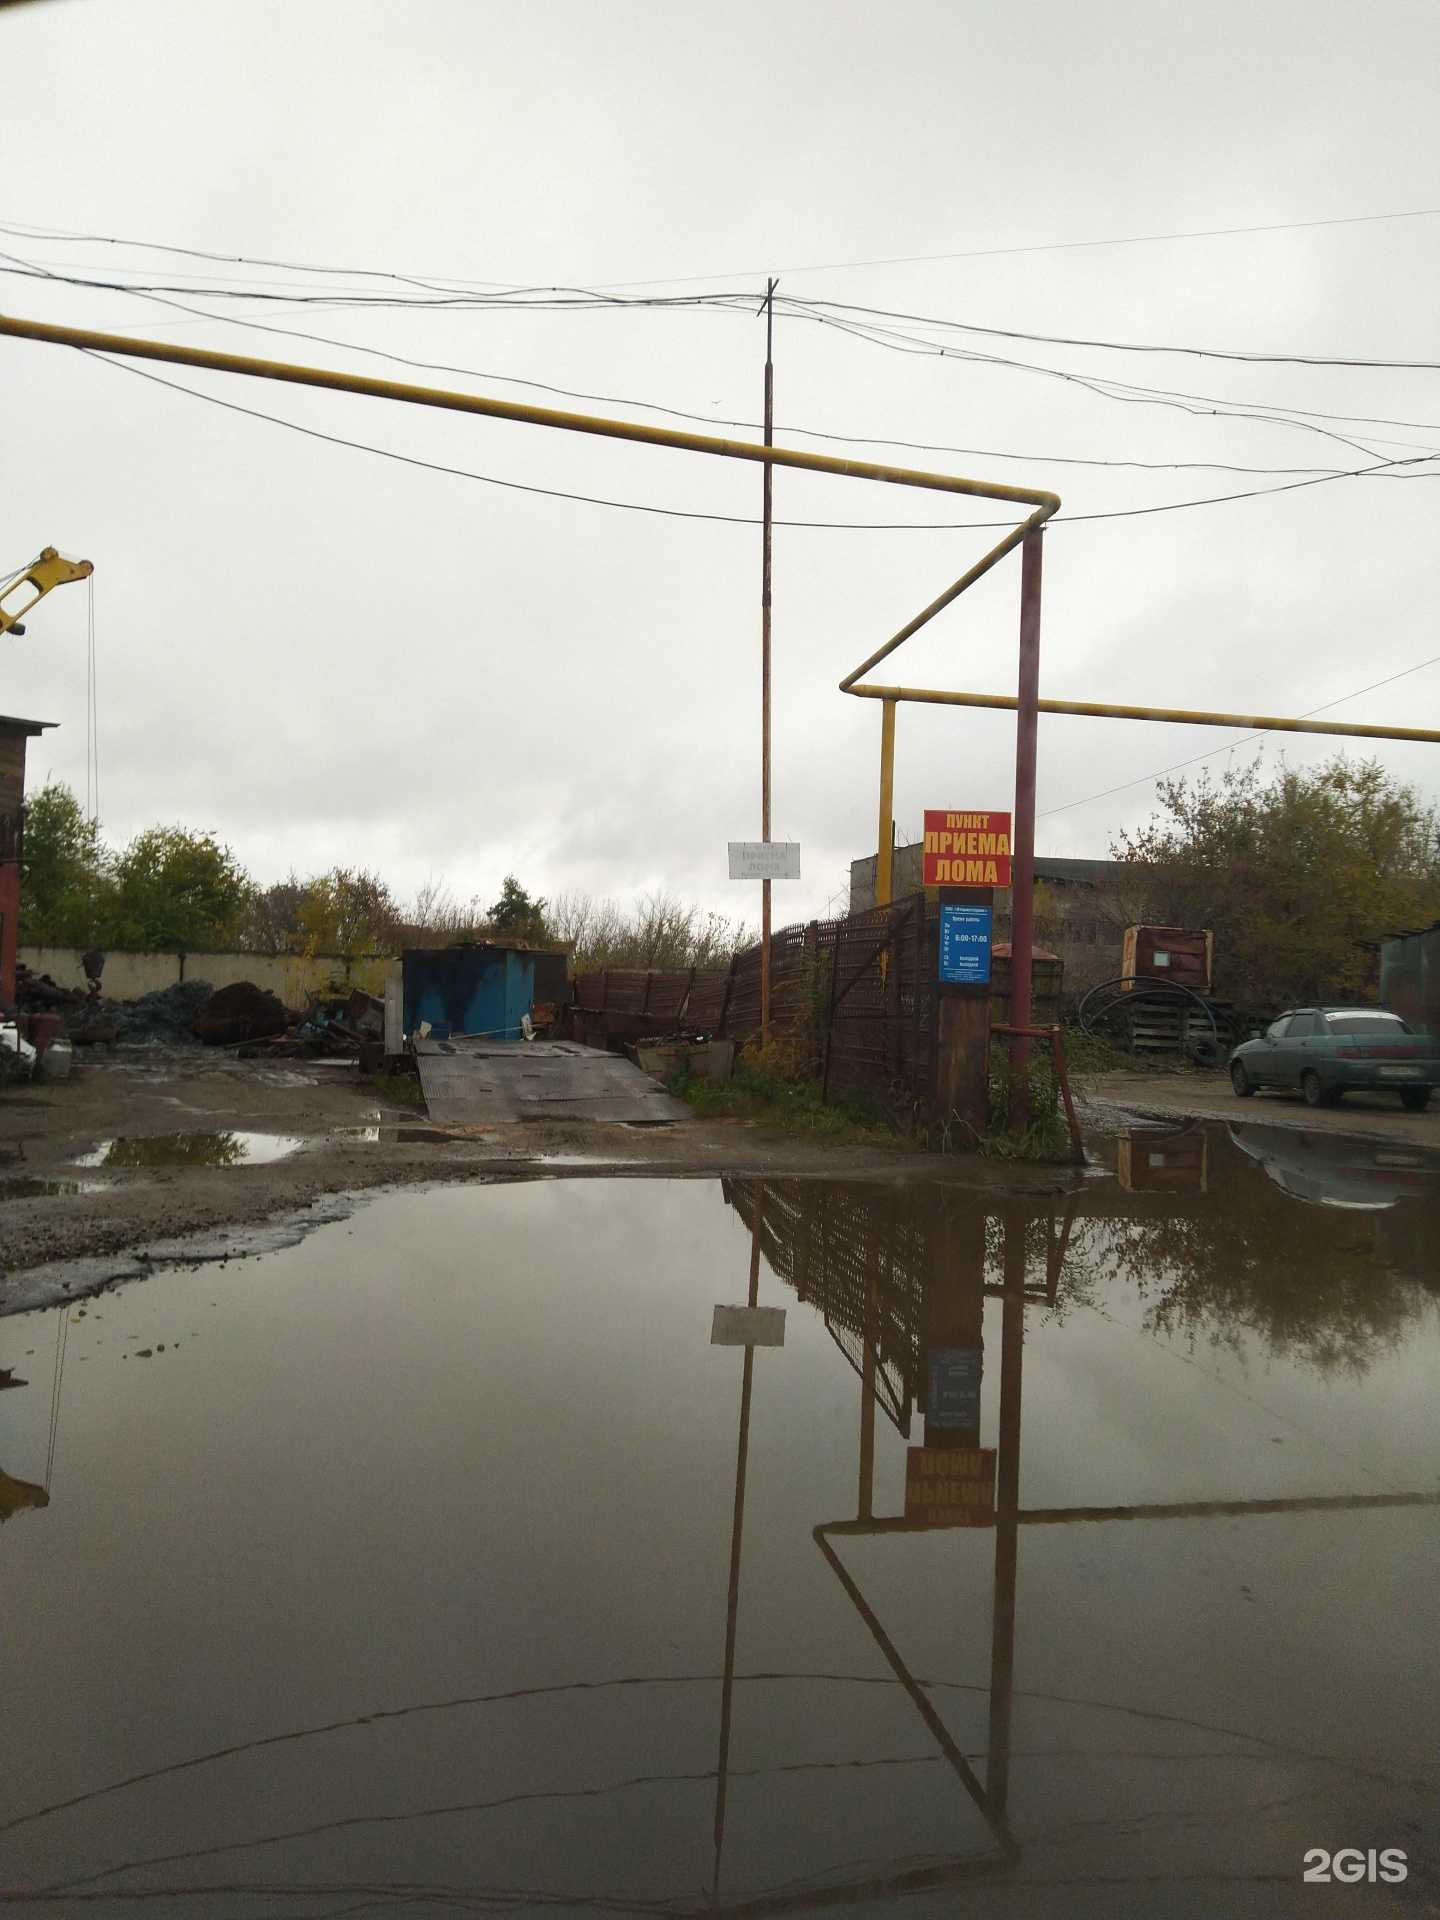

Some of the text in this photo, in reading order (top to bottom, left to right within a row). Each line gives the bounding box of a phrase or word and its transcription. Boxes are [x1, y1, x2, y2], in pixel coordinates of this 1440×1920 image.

[946, 814, 990, 829] ПУНКТ
[924, 831, 1010, 855] ПРИЕМА
[935, 859, 998, 883] ЛОМА
